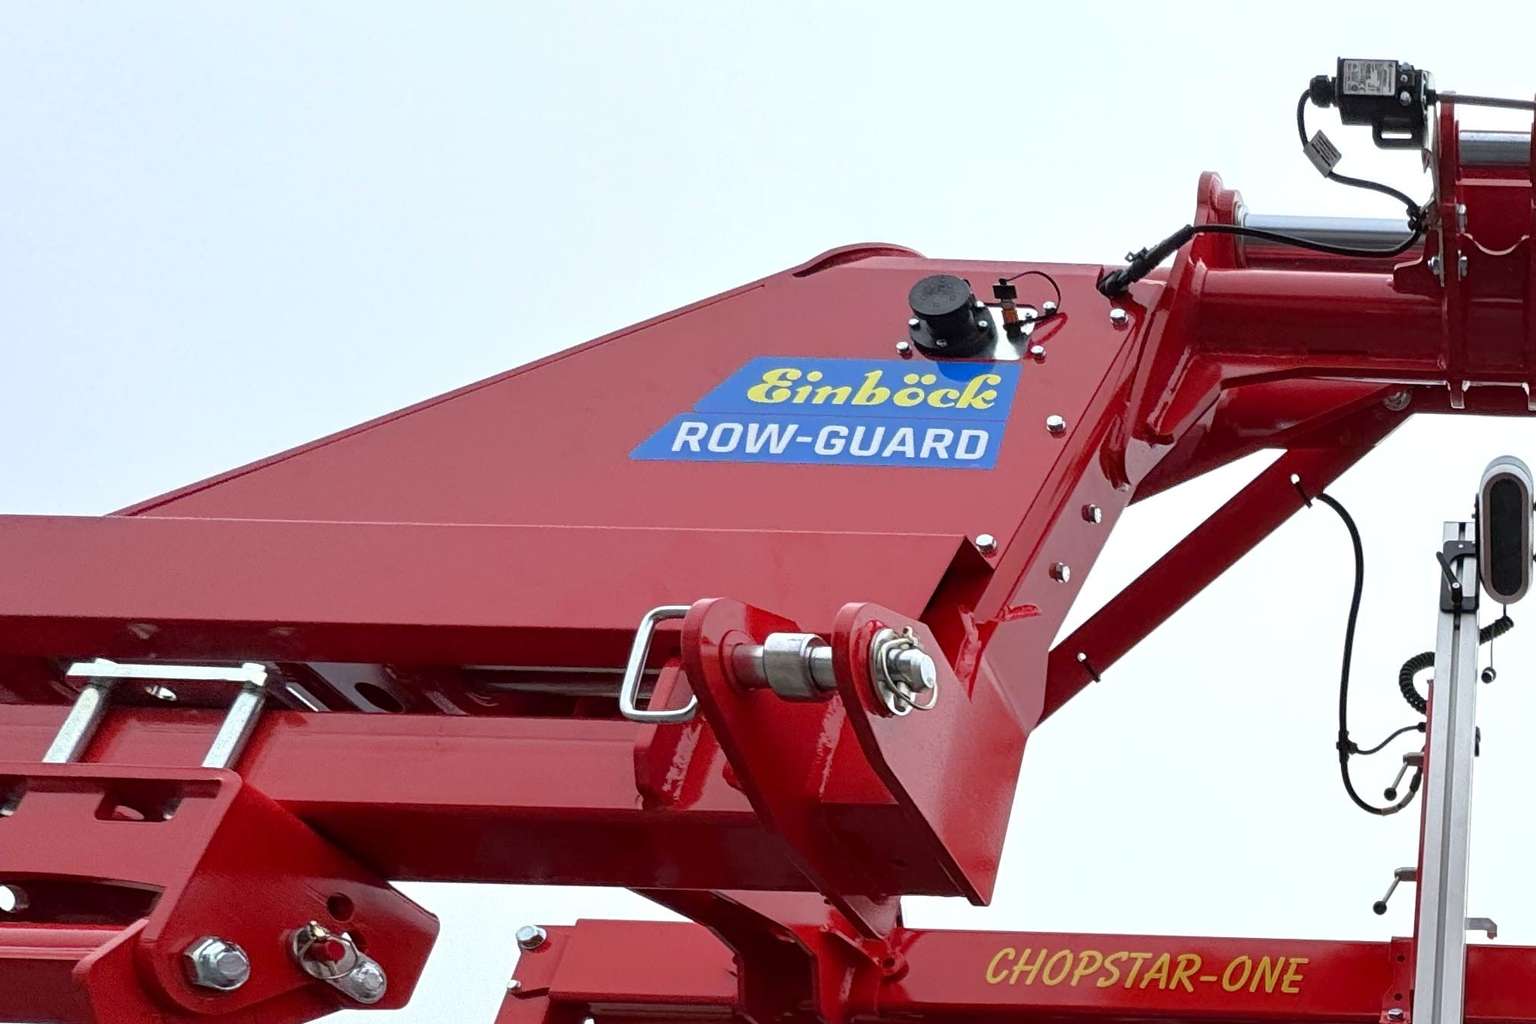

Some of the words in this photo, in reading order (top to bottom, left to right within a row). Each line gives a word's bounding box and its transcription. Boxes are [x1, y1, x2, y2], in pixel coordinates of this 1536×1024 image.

[747, 368, 1002, 410] Einböck
[671, 421, 990, 461] ROW-GUARD
[985, 947, 1309, 994] CHOPSTAR-ONE
